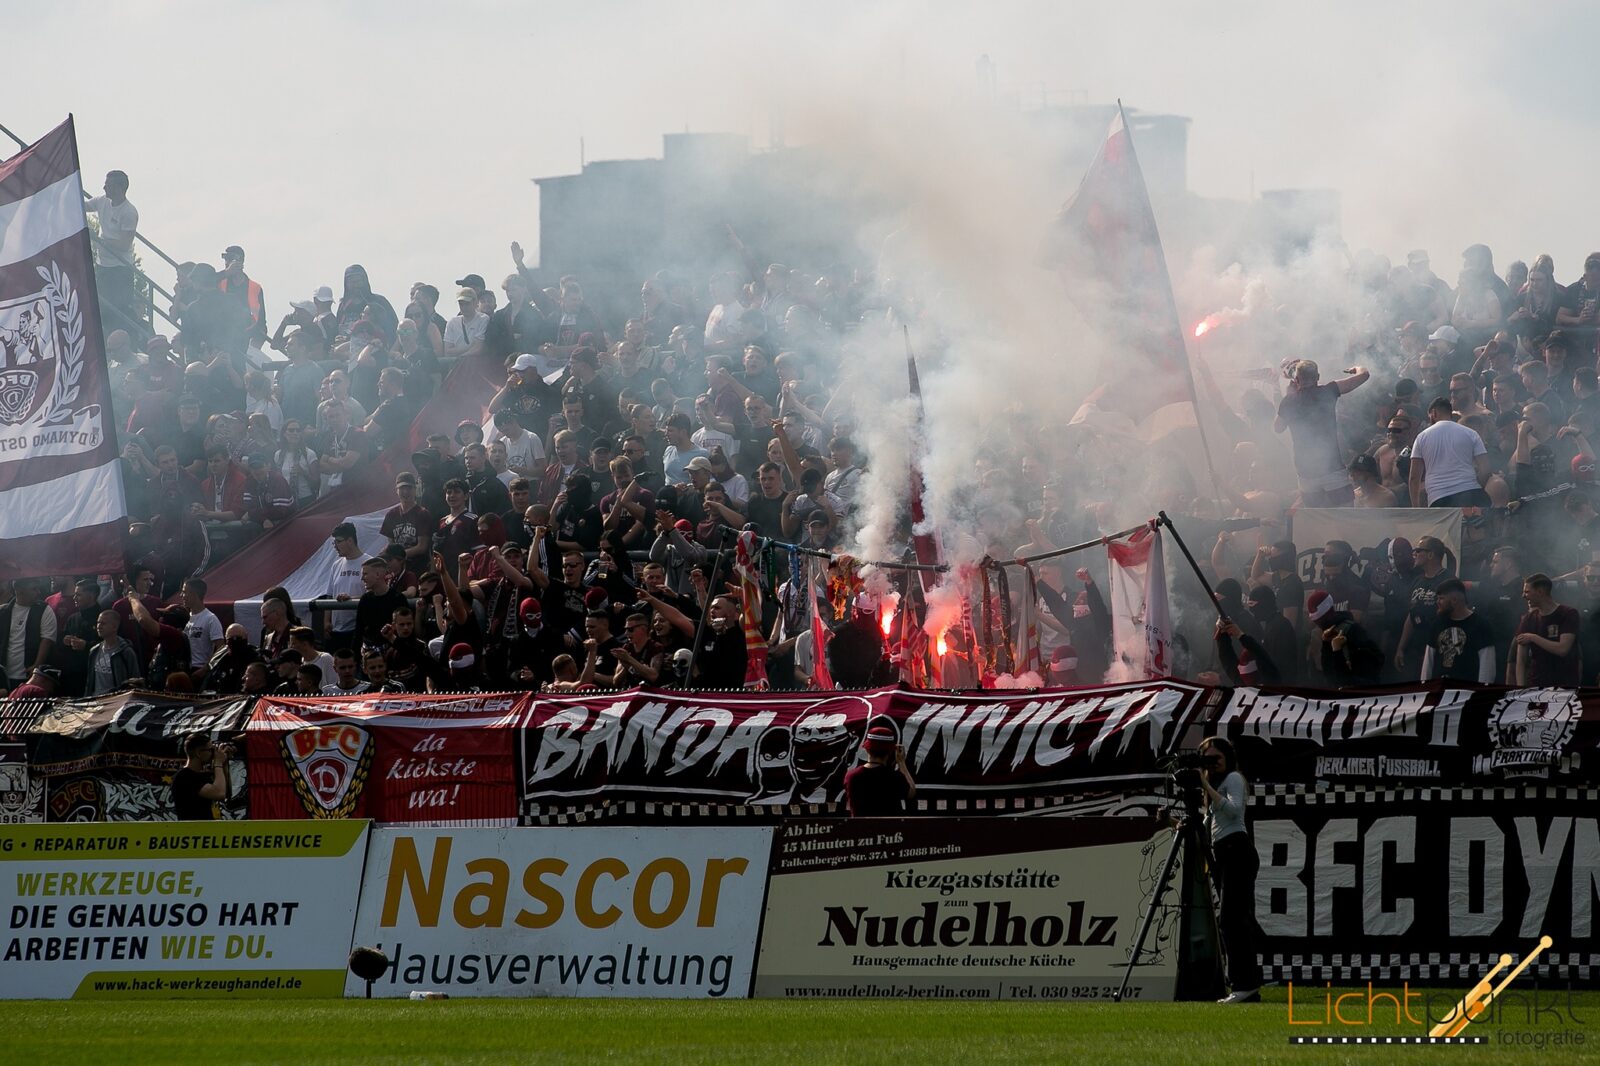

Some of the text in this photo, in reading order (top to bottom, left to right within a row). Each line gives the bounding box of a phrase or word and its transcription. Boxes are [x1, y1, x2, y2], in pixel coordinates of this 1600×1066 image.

[292, 724, 362, 760] BFC
[413, 733, 447, 752] da
[527, 700, 778, 786] BANDA
[900, 688, 1185, 776] INVICTA
[386, 756, 477, 780] kiekste
[1315, 755, 1441, 778] BERLINER FUSSBALL
[50, 779, 97, 818] BFC
[408, 784, 461, 809] wa!
[0, 815, 26, 824] 966
[784, 822, 834, 837] Ab hier
[0, 834, 323, 851] G REPARATUR BAUSTELLENSERVICE
[781, 831, 905, 854] 15 Minuten zu Fuß
[780, 844, 962, 868] Falkenberger Str. 37A 13088 Berlin
[16, 871, 204, 898] WERKZEUGE,
[380, 836, 751, 930] Nascor
[884, 866, 1060, 895] Kiezgaststätte
[1252, 816, 1417, 937] BFC
[9, 902, 299, 929] DIE GENAUSO HART
[943, 899, 970, 908] zum
[817, 900, 1119, 949] Nudelholz
[3, 935, 273, 962] ARBEITEN WIE DU.
[850, 953, 1076, 968] Hausgemachte deutsche Küche
[94, 977, 303, 994] www.hack-werkzeughandel.de
[784, 982, 991, 1000] www.nudelholz-berlin.com
[1009, 985, 1037, 998] Tel.
[1040, 986, 1068, 998] 030
[1071, 986, 1099, 998] 925
